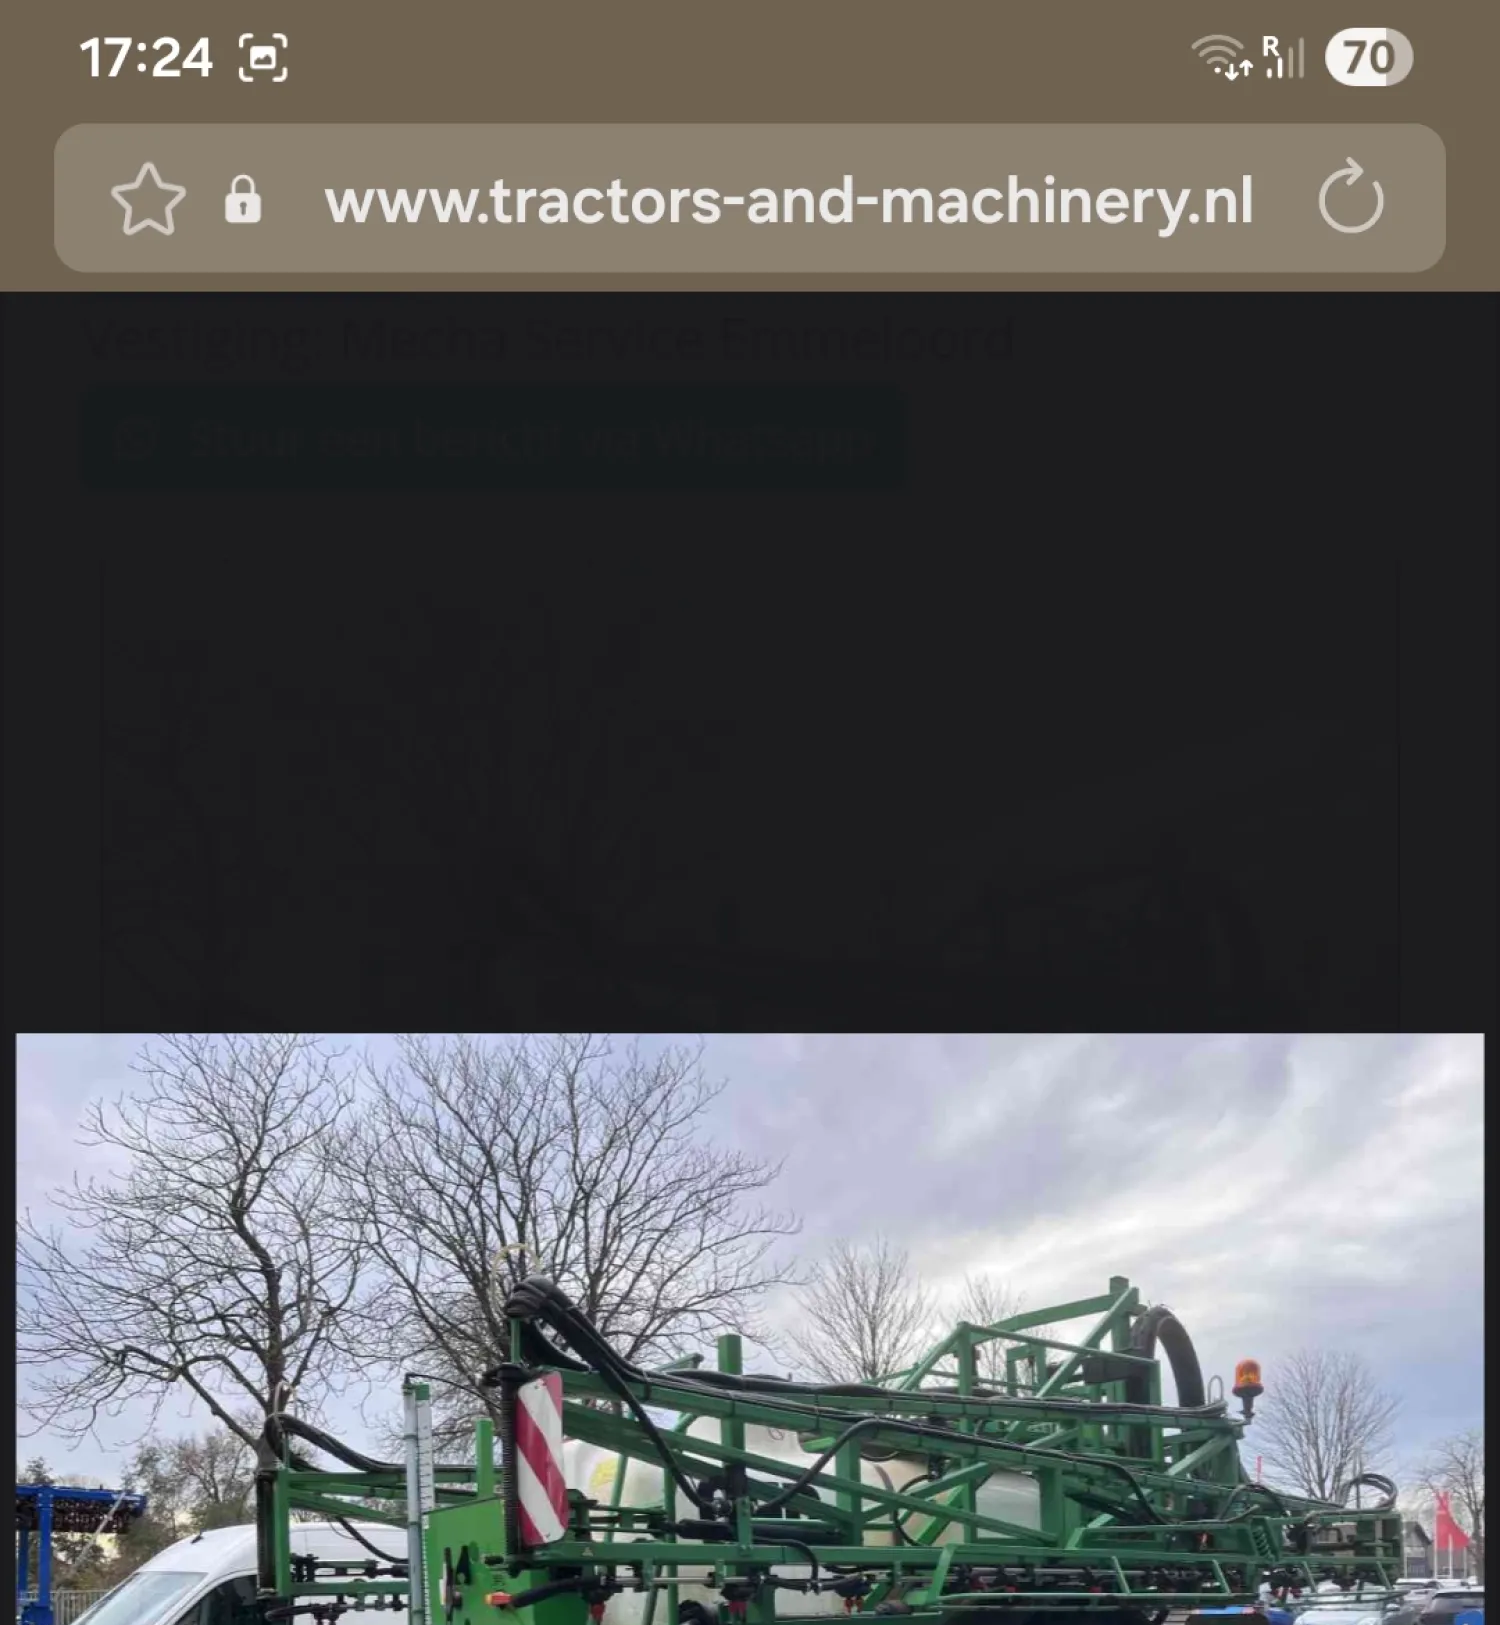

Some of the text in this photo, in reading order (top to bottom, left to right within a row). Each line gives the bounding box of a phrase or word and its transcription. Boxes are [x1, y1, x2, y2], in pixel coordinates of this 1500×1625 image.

[79, 36, 214, 77] 17:24
[1343, 40, 1395, 74] 70
[324, 174, 1253, 239] www.tractors-and-machinery.nl
